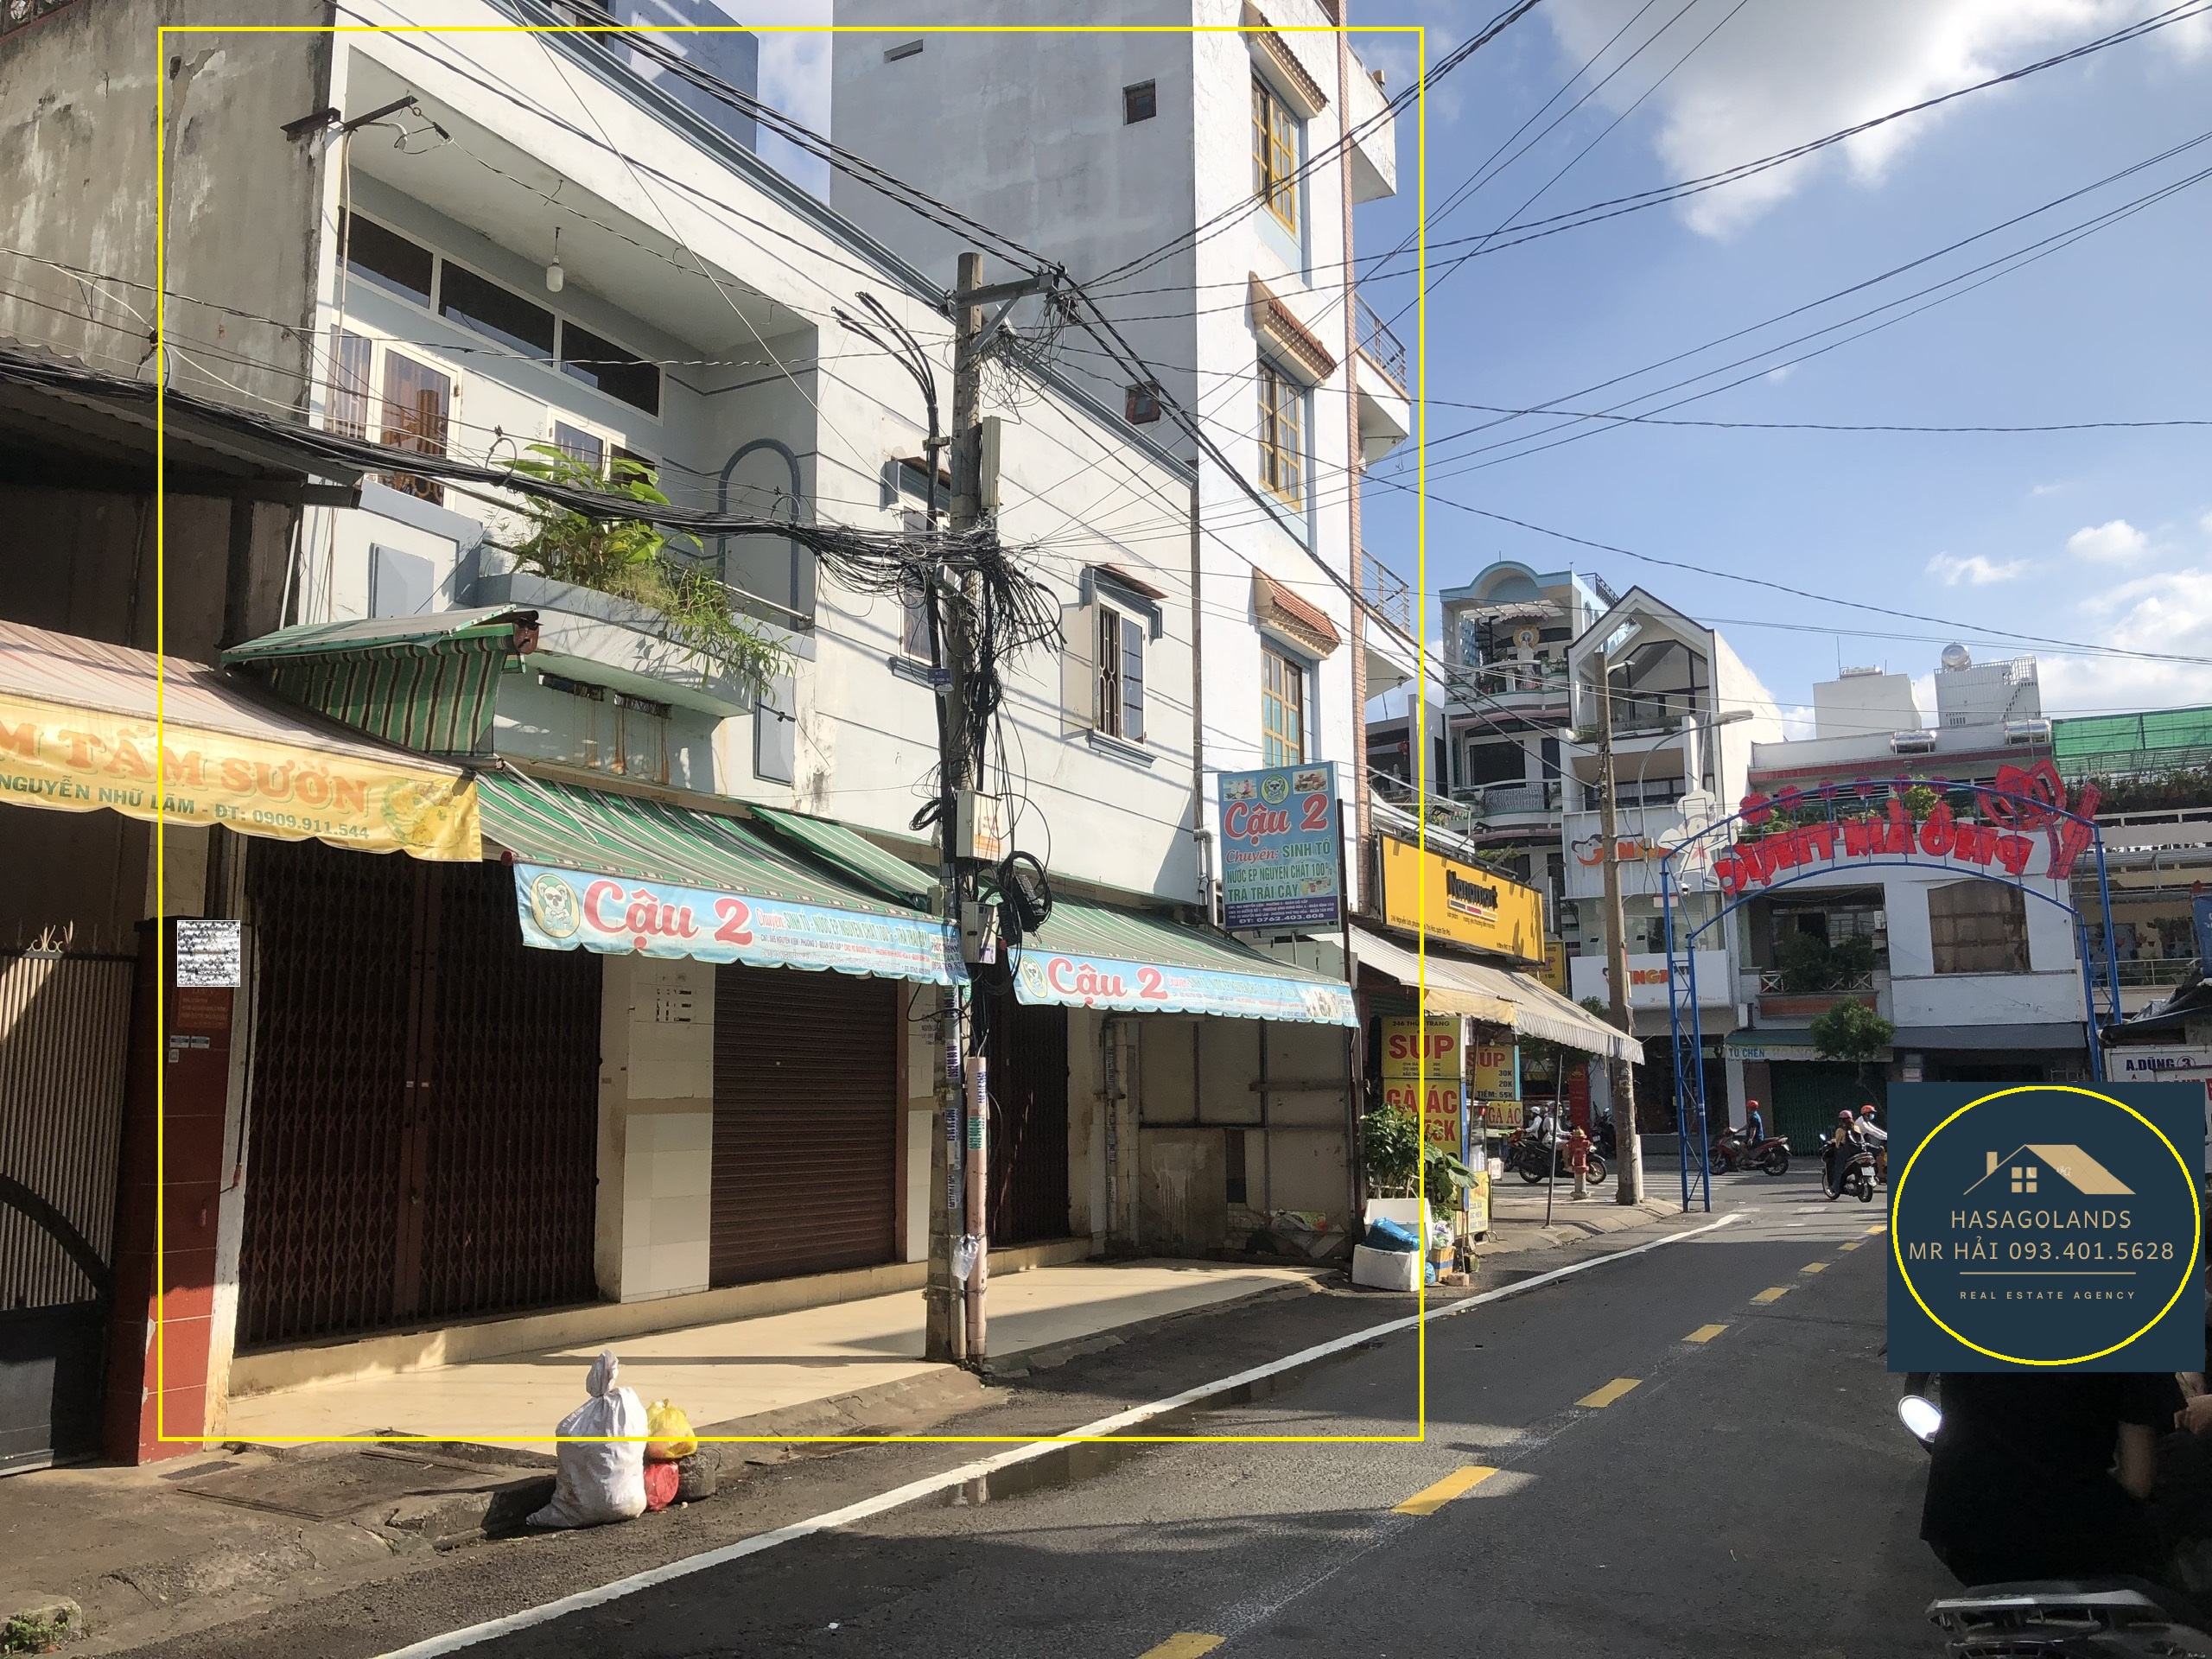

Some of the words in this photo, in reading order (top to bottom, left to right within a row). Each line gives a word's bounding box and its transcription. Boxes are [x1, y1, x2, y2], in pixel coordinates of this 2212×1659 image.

[58, 724, 205, 786] TẤM
[220, 758, 368, 813] SƯỜN
[0, 774, 90, 801] NGUYỄN
[99, 787, 144, 808] NHỮ
[150, 792, 195, 815] LÃM
[215, 804, 247, 822] ĐT:
[251, 809, 370, 840] 0909.911.544
[1224, 801, 1291, 845] Cậu
[1300, 793, 1328, 830] 2
[1226, 848, 1280, 864] Chuyên:
[1282, 842, 1312, 858] SINH
[1315, 836, 1332, 855] TỐ
[1227, 868, 1247, 884] NƯỚC
[1248, 866, 1258, 882] ÉP
[1260, 862, 1289, 881] NGUYÊN
[1290, 860, 1310, 879] CHẤT
[1312, 862, 1332, 878] 100%
[1228, 887, 1249, 902] TRÀ
[1250, 883, 1274, 900] TRÁI
[1278, 882, 1299, 899] CÂY
[582, 880, 702, 950] Cậu
[713, 897, 753, 946] 2
[1256, 912, 1325, 923] 0762.403.808
[1047, 957, 1128, 1005] Cậu
[1136, 967, 1168, 1001] 2
[2126, 1055, 2175, 1071] A.DŨNG
[2182, 1057, 2192, 1067] 3
[1426, 1084, 1458, 1115] ÁC
[1488, 1103, 1503, 1123] GÀ
[1506, 1103, 1522, 1123] ÁC
